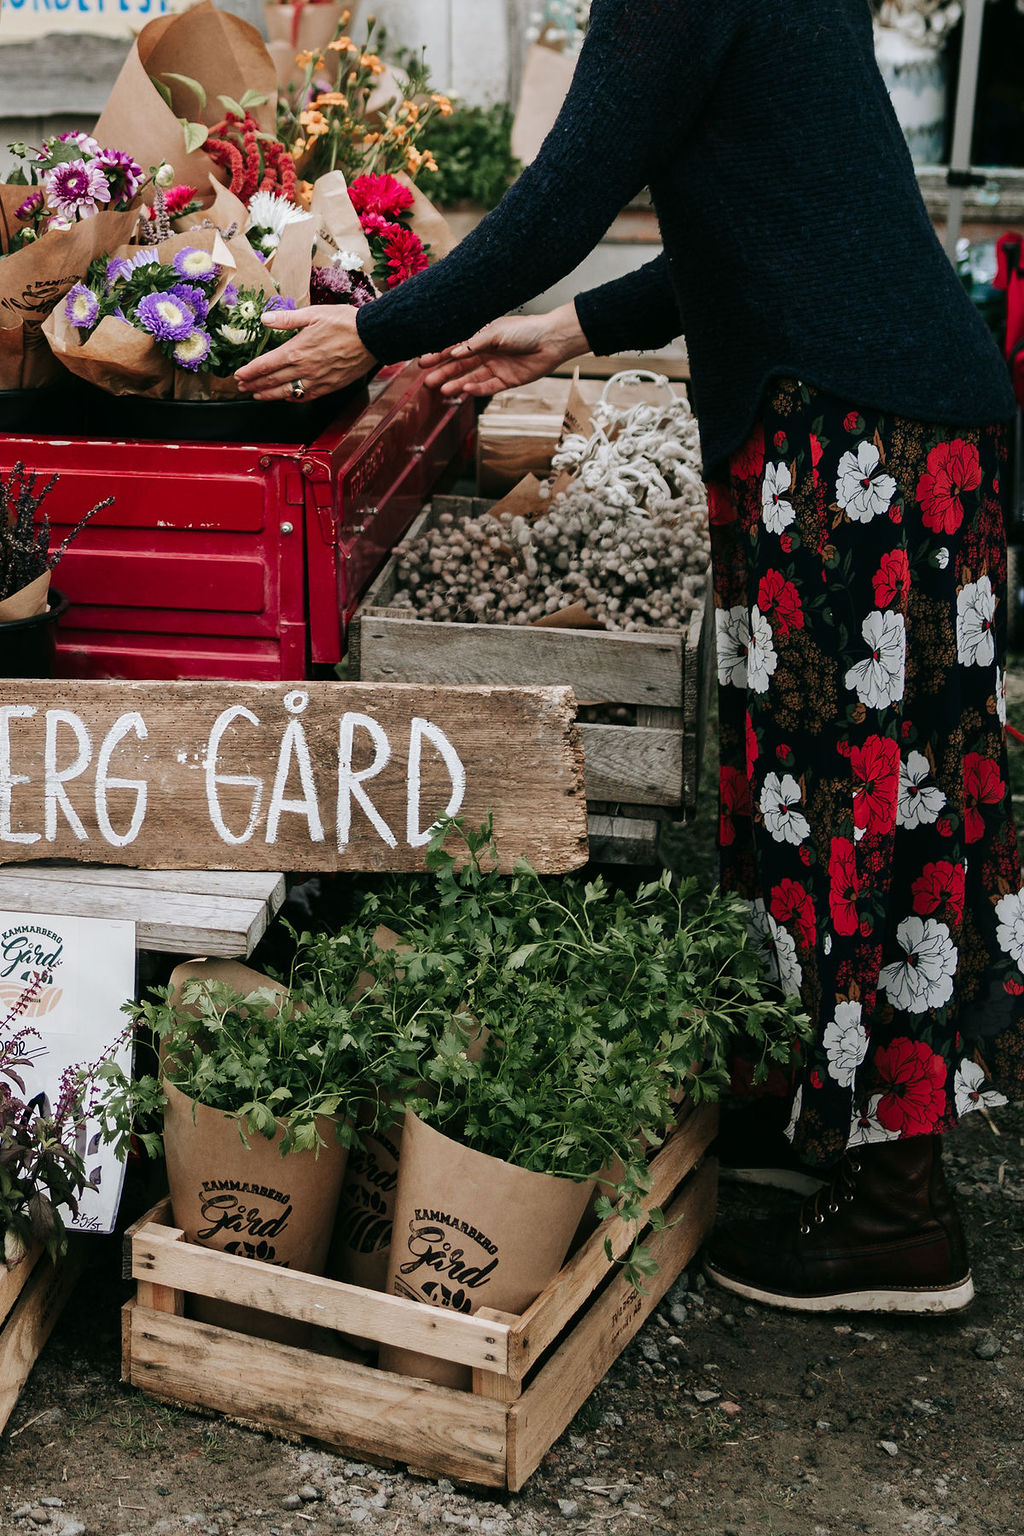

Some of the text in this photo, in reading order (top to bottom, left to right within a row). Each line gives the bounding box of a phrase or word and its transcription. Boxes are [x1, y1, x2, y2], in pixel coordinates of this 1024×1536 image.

[204, 690, 467, 853] GÅRD
[0, 936, 64, 978] Gård
[2, 926, 63, 944] KAMMARBERG
[198, 1191, 293, 1239] Gård
[202, 1179, 291, 1205] KAMMARBERG
[400, 1220, 501, 1289] Gård
[414, 1208, 499, 1256] KAMMARBERG
